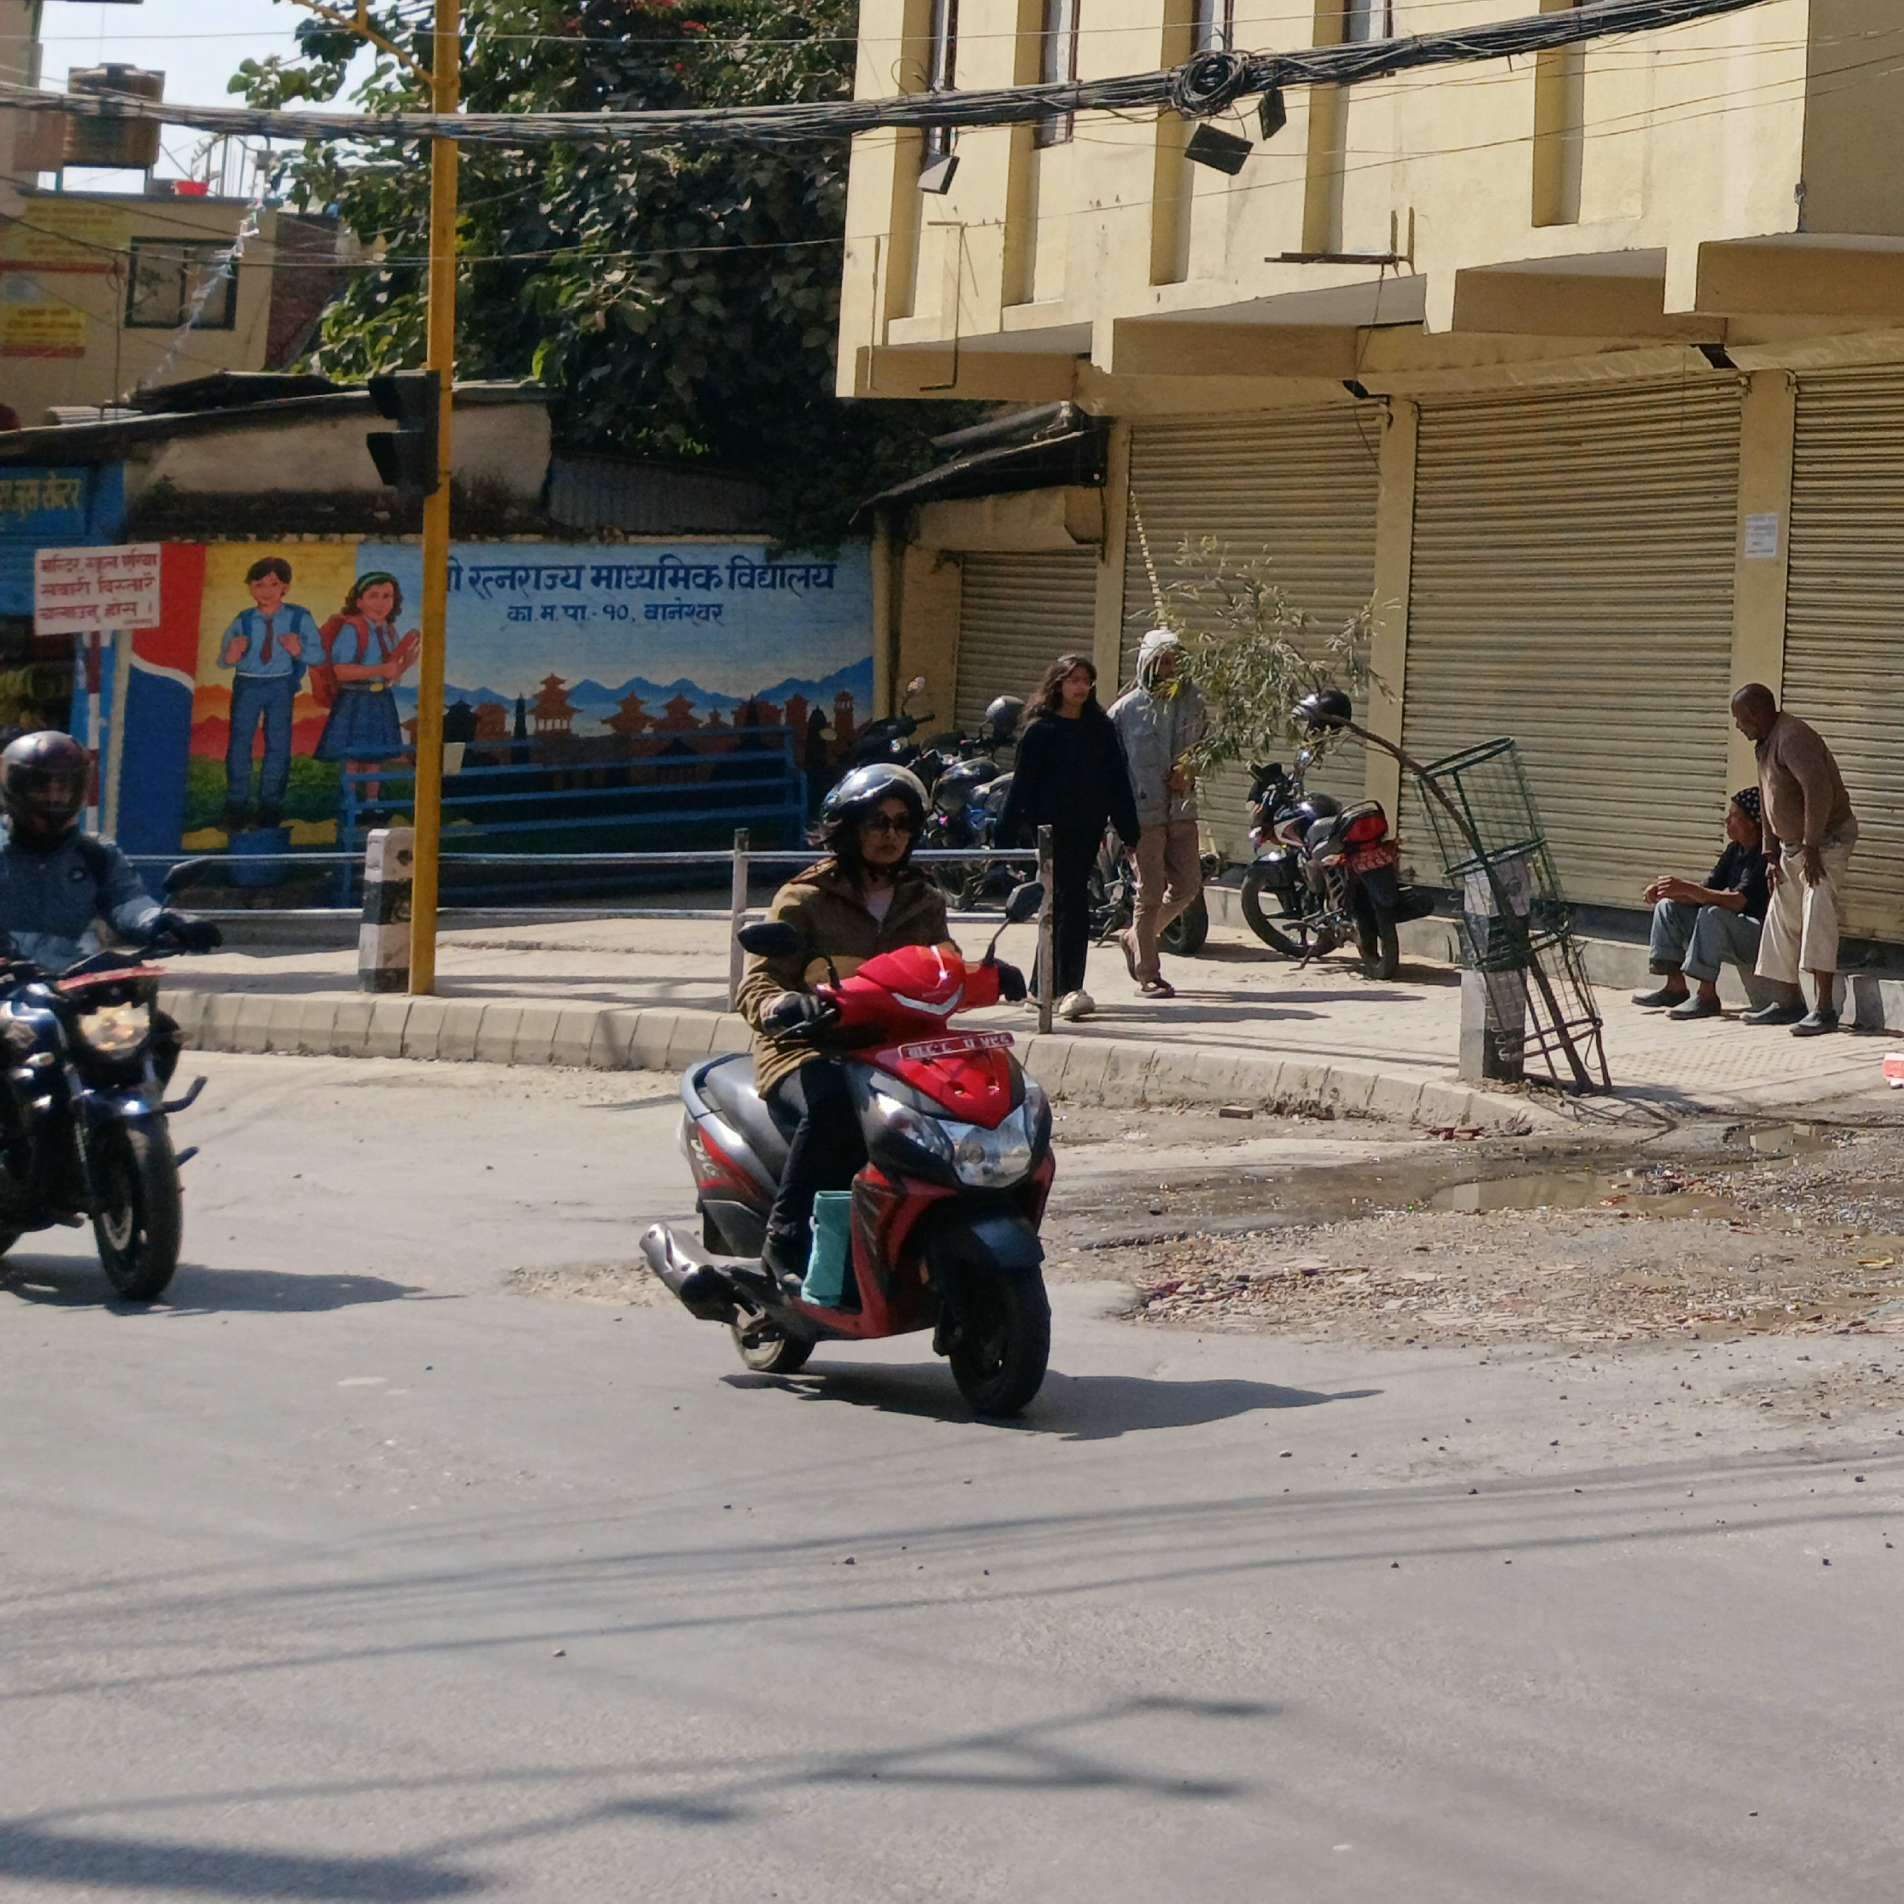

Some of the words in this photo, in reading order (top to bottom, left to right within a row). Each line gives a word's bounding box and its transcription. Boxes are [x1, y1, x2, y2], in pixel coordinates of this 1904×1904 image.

[467, 565, 584, 599] रत्नराज्य
[591, 553, 724, 592] माध्यमिक
[725, 554, 838, 599] विद्यालय
